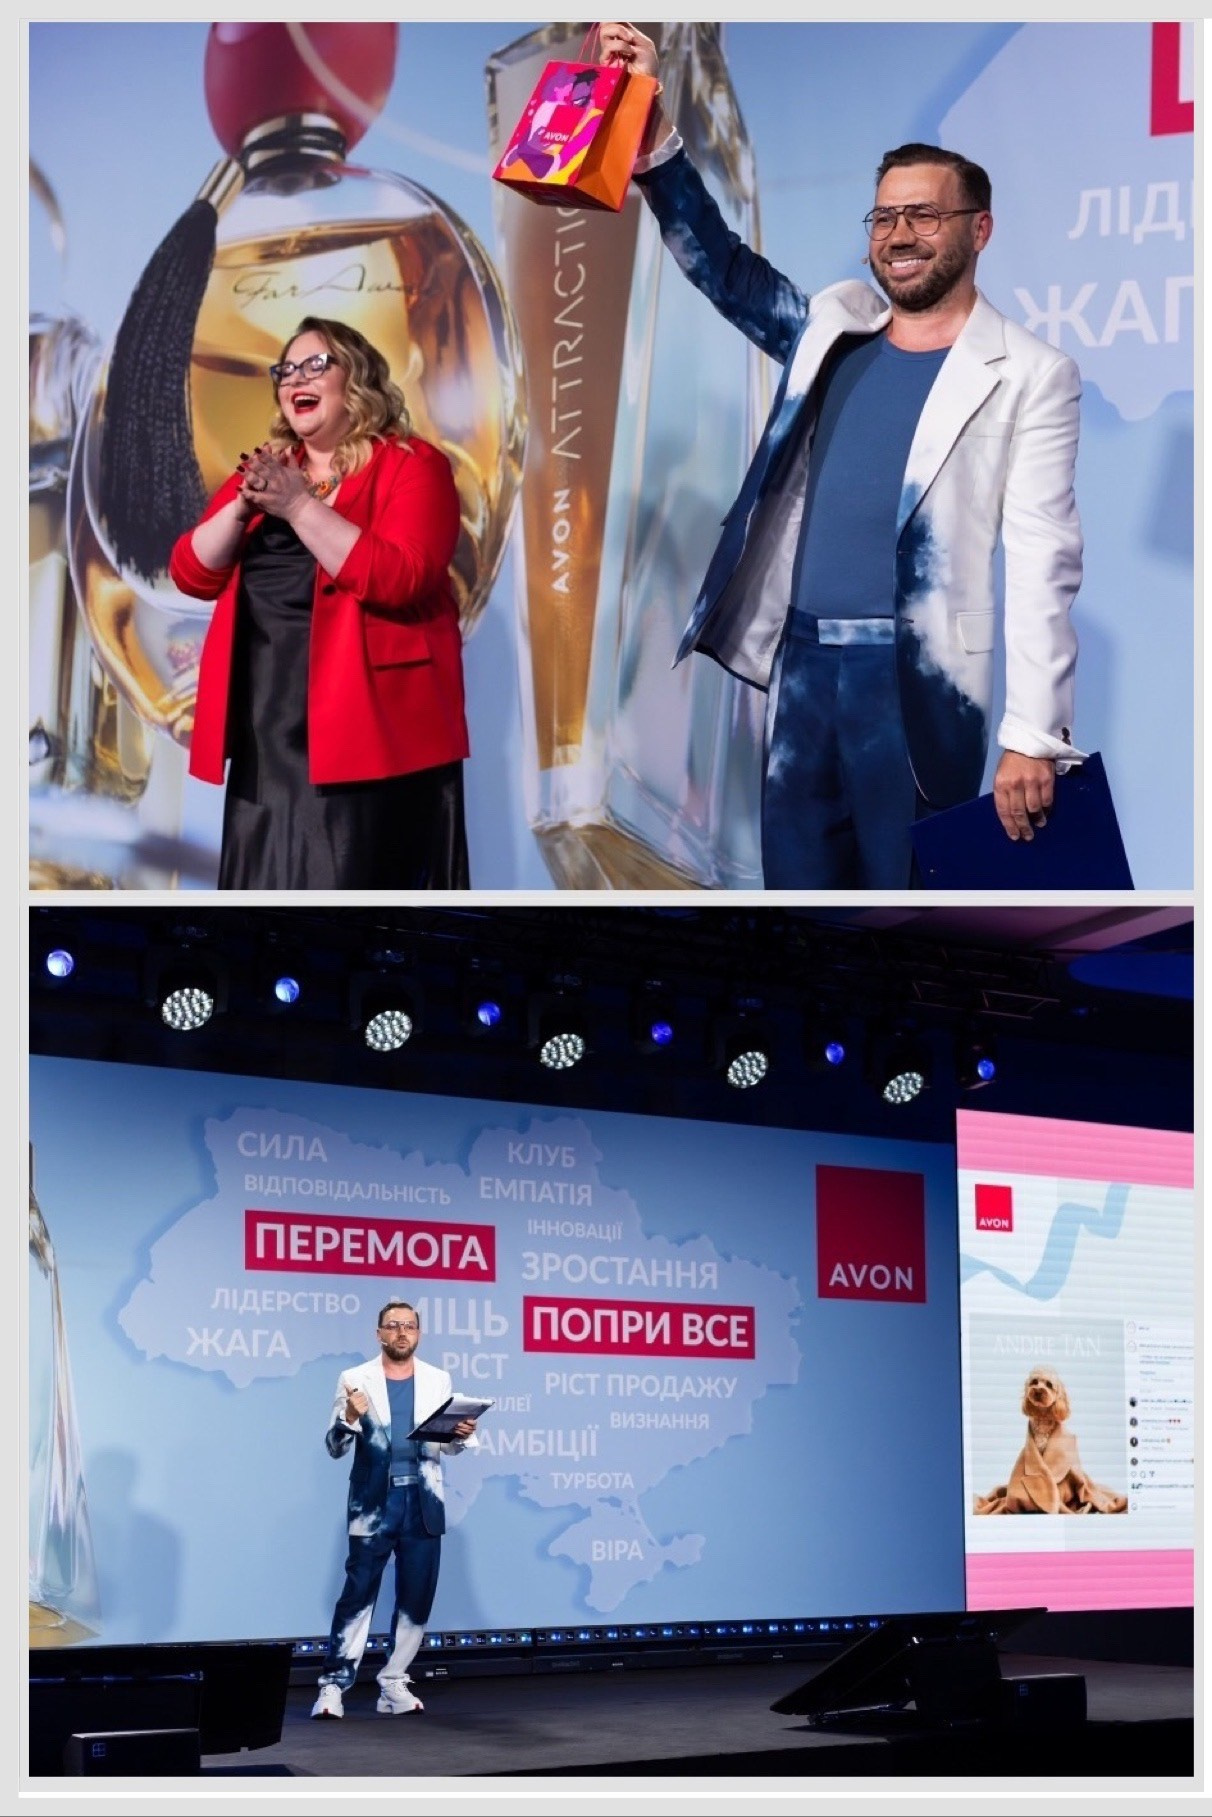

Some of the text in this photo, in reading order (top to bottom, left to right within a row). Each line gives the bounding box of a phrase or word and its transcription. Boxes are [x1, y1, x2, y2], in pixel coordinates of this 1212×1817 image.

[543, 131, 570, 142] AVON
[1067, 180, 1194, 245] ЛІД
[552, 488, 571, 594] AVON
[237, 1131, 327, 1163] СИЛА
[508, 1142, 576, 1168] КЛУБ
[245, 1174, 451, 1205] ВІДПОВІДАЛЬНІСТЬ
[480, 1176, 593, 1207] ЕМПАТІЯ
[527, 1219, 623, 1243] ІННОВАЦІЇ
[979, 1217, 1009, 1229] AVON
[256, 1222, 489, 1271] ПЕРЕМОГА
[521, 1251, 719, 1290] ЗРОСТАННЯ
[829, 1262, 913, 1292] AVON
[211, 1287, 361, 1316] ЛІДЕРСТВО
[532, 1306, 749, 1348] ПОПРИ ВСЕ
[186, 1327, 292, 1359] ЖАГА
[442, 1352, 510, 1380] РІСТ
[545, 1372, 738, 1402] РІСТ ПРОДАЖУ
[610, 1411, 710, 1430] ВИЗНАННЯ
[474, 1424, 600, 1463] АМБІЦІЇ
[550, 1472, 635, 1490] ТУРБОТА
[592, 1539, 645, 1562] ВІРА
